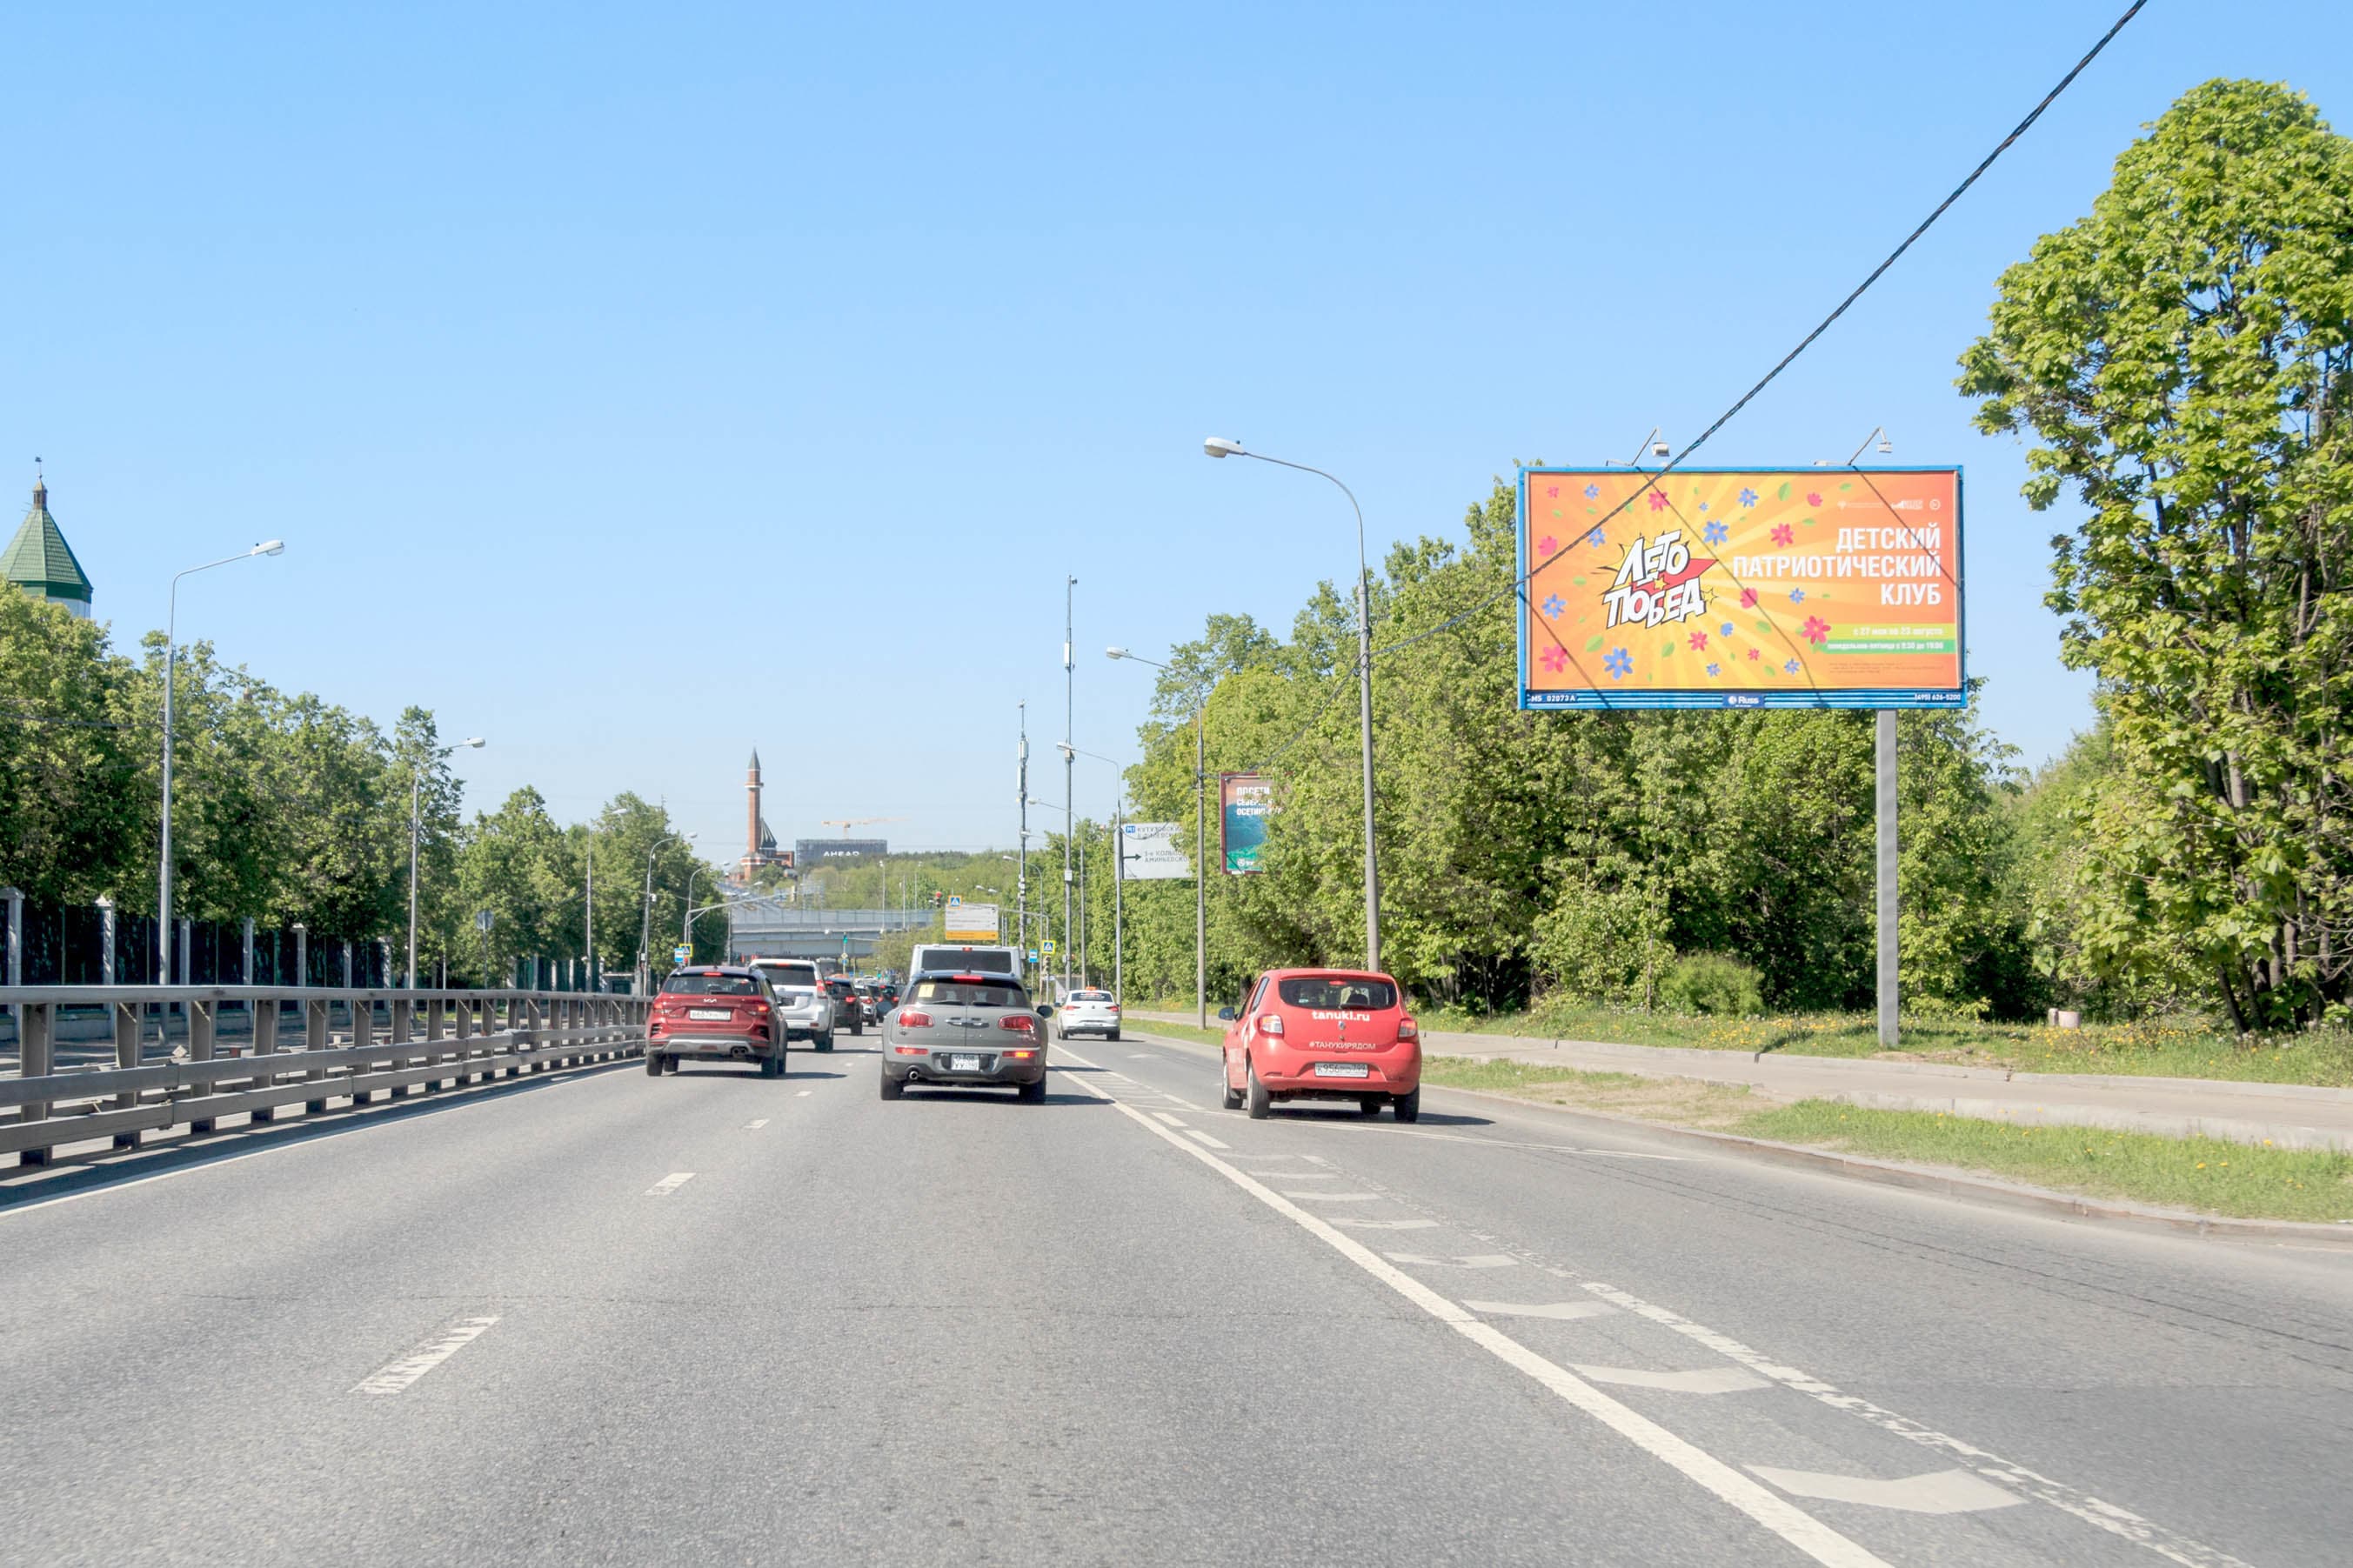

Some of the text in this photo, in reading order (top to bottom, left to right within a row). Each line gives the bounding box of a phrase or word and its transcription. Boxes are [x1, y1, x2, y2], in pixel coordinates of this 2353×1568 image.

[1836, 522, 1941, 553] ДЕТСКИЙ
[1613, 529, 1690, 588] ЛЕТО
[1732, 550, 1941, 577] ПАТРИОТИЧЕСКИЙ
[1601, 576, 1707, 630] ПОБЕД
[1881, 584, 1941, 605] КЛУБ
[1312, 1011, 1370, 1022] tanuki.ru
